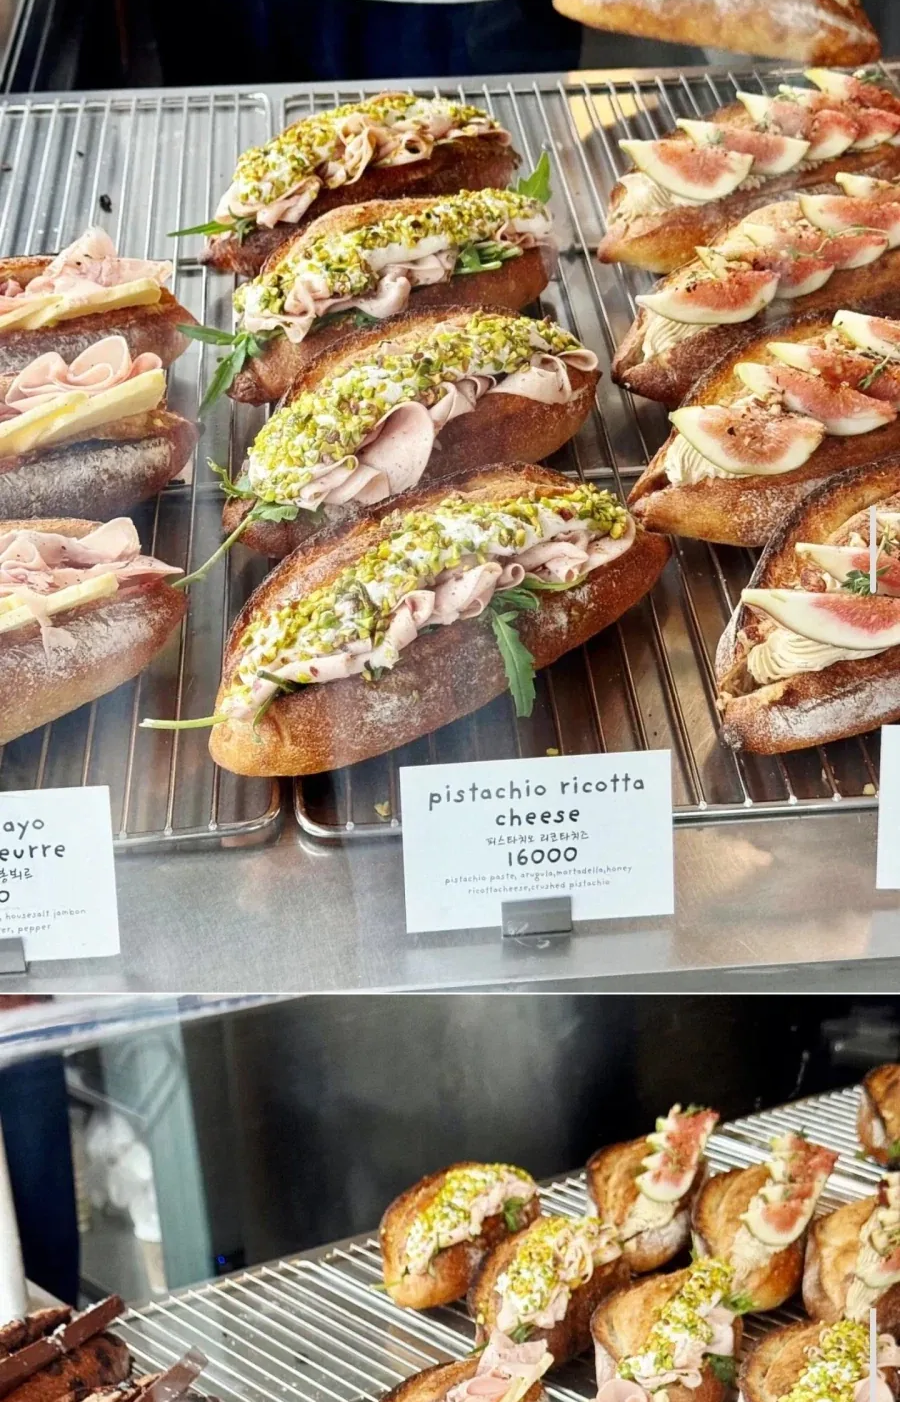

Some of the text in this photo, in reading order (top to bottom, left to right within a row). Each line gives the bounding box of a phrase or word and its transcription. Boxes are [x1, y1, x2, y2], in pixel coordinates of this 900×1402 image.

[428, 773, 645, 811] pistachio ricotta
[495, 808, 580, 827] cheese
[508, 846, 578, 866] 16000
[445, 874, 486, 885] pistachio
[569, 879, 610, 889] pistachio
[53, 908, 86, 919] jambon
[17, 924, 51, 934] pepper
